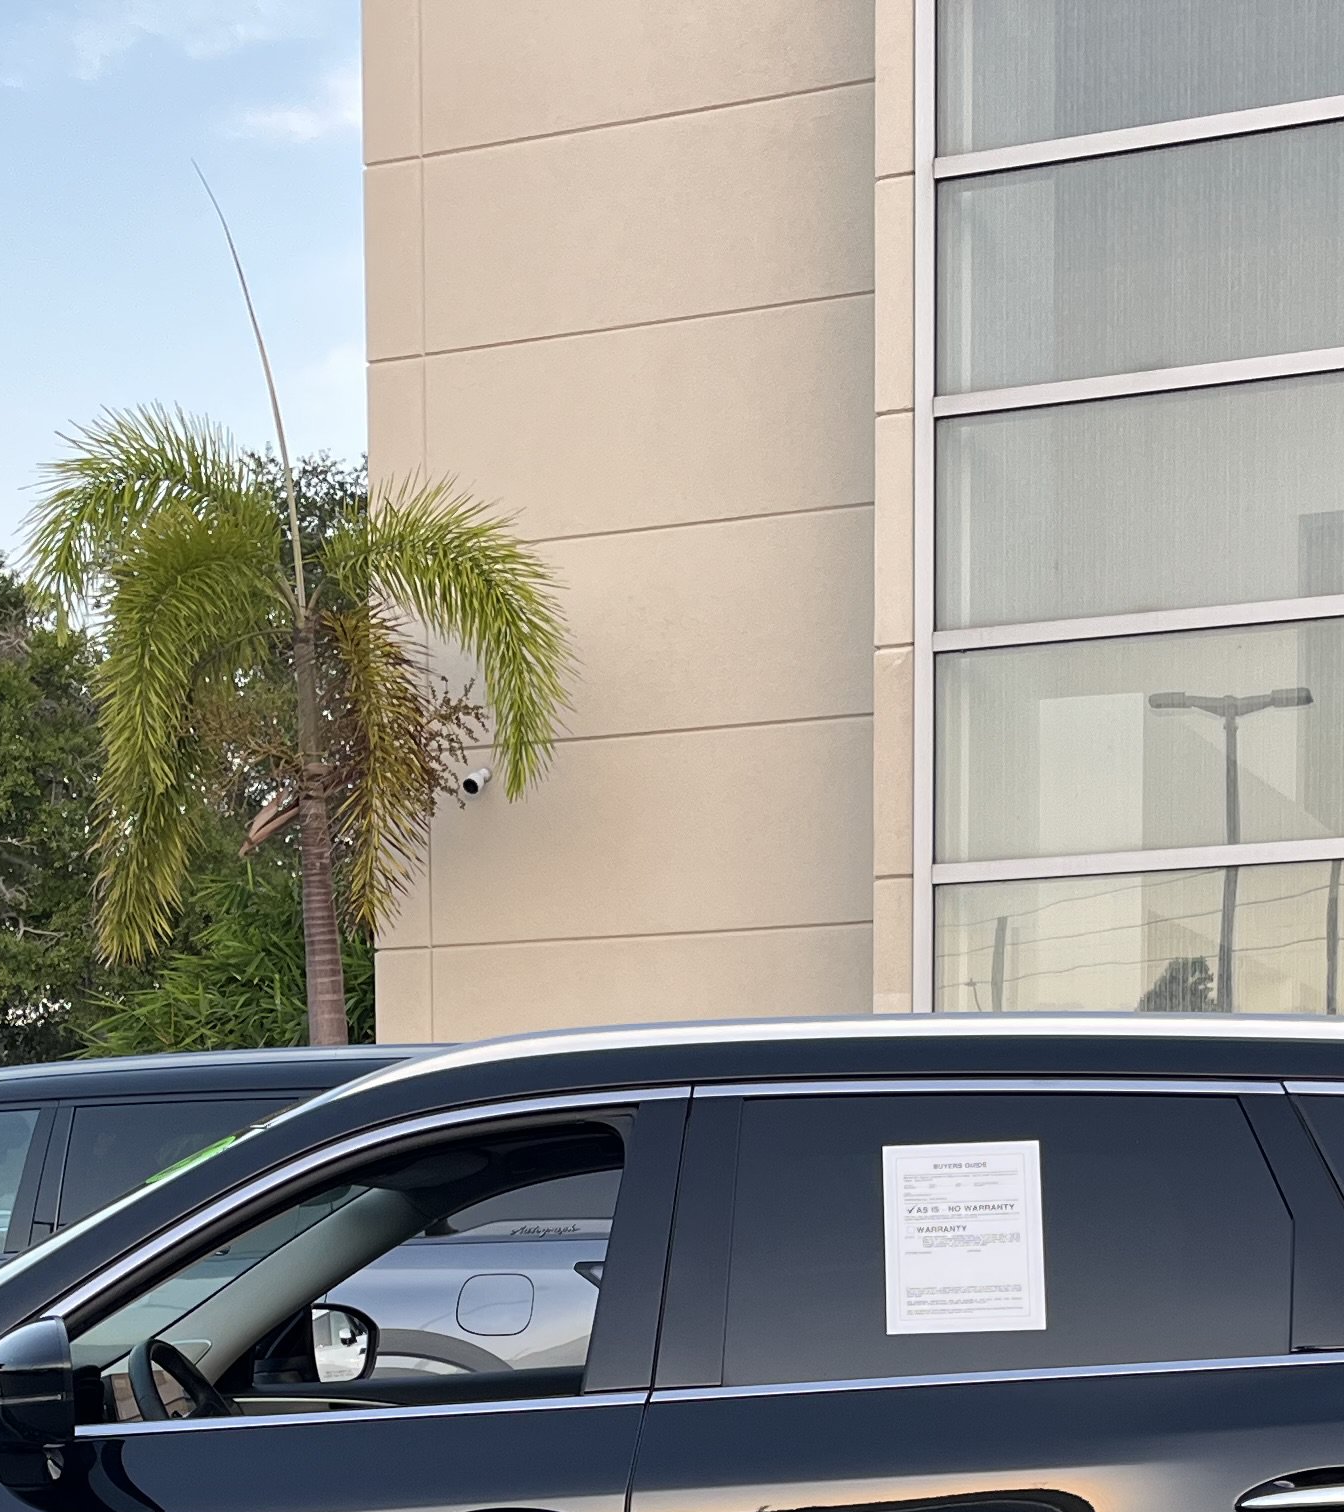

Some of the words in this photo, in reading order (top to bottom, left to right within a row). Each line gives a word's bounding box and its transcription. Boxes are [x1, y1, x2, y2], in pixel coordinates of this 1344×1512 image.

[916, 1206, 929, 1214] AS
[948, 1205, 961, 1213] NO
[964, 1203, 1015, 1212] WARRANTY
[916, 1224, 967, 1234] WARRANTY
